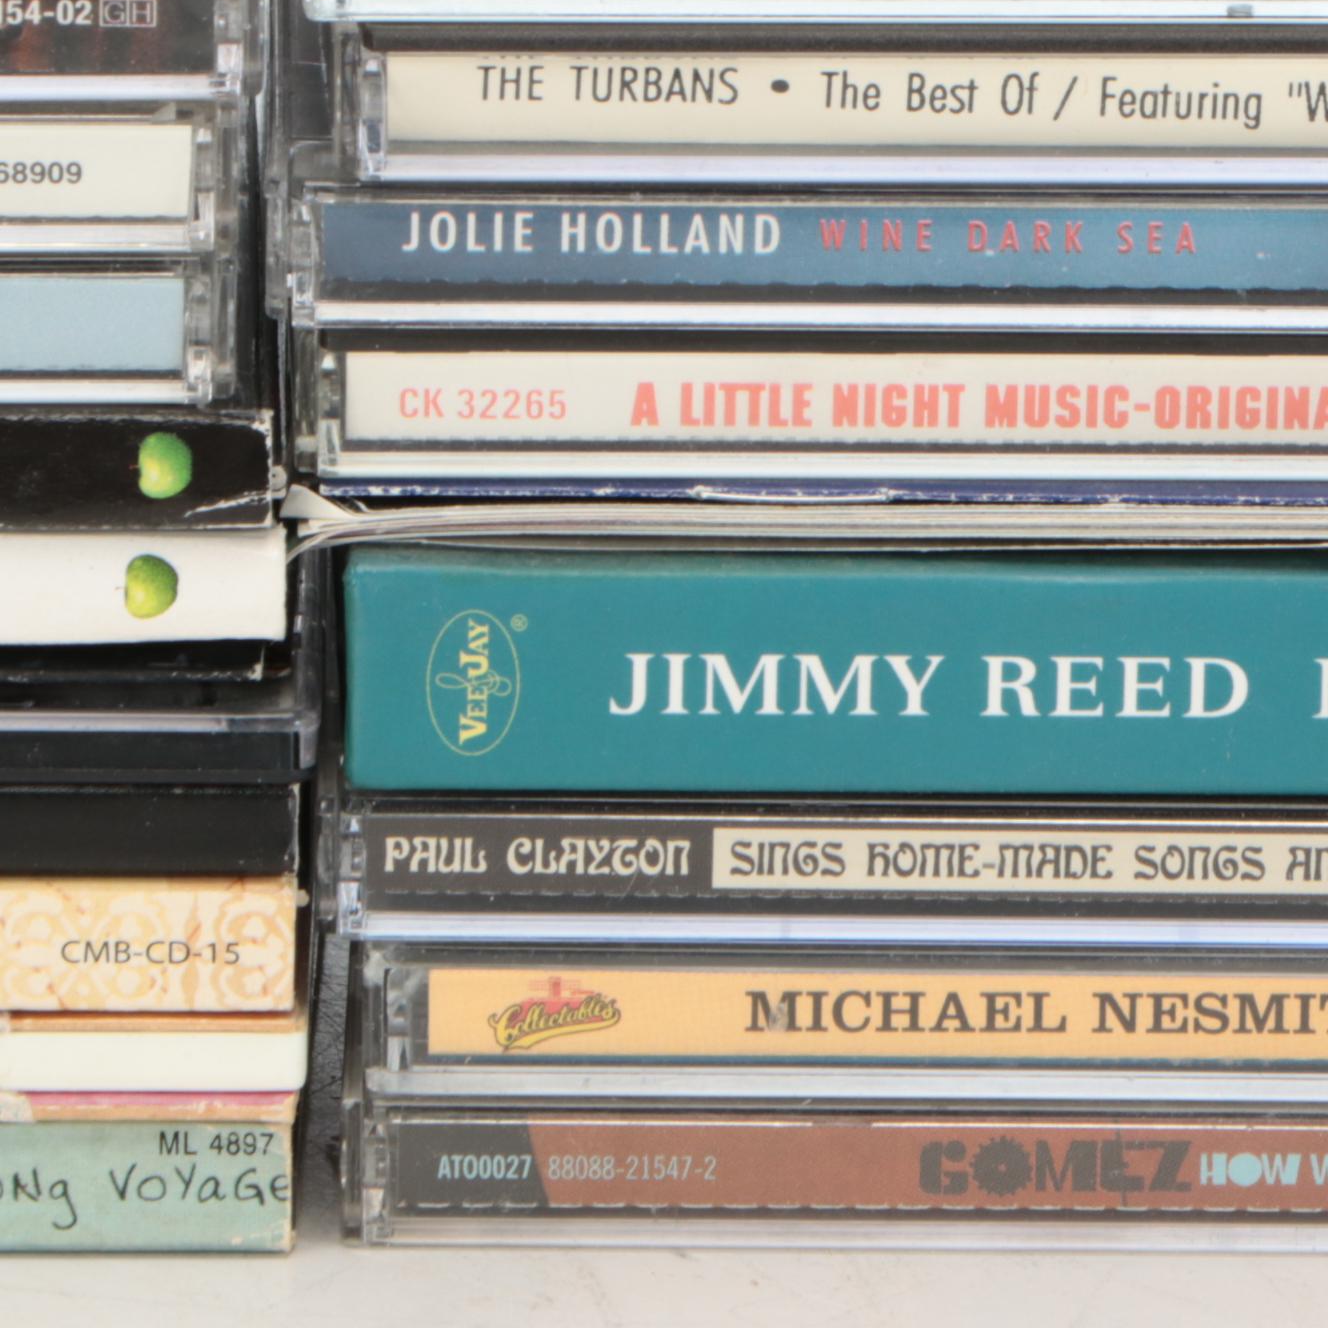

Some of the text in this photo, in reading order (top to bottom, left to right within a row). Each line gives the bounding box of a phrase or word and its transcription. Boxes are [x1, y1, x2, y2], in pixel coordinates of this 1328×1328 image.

[478, 65, 544, 100] THE
[570, 66, 738, 104] TURBANS
[821, 70, 880, 111] The
[907, 72, 978, 114] Best
[1001, 72, 1039, 116] Of
[1100, 76, 1262, 130] Featuring
[402, 211, 533, 252] JOLIE
[561, 211, 780, 255] HOLLAND
[820, 219, 931, 251] WINE
[968, 220, 1082, 254] DARK
[1117, 221, 1196, 254] SEA
[400, 388, 444, 419] CK
[458, 388, 567, 420] 32265
[631, 382, 659, 426] A
[681, 383, 813, 428] LITTLE
[832, 384, 966, 428] NIGHT
[610, 653, 944, 715] JIMMY
[982, 656, 1248, 717] REED
[385, 836, 487, 873] PAUL
[507, 837, 690, 876] CLAYTON
[730, 840, 845, 877] SINGS
[867, 842, 1113, 879] HOME-MADE
[1134, 844, 1265, 881] SONGS
[60, 940, 240, 964] CMB-CD-15
[487, 993, 622, 1048] Collectables
[746, 990, 1066, 1033] MICHAEL
[159, 1130, 274, 1156] ML 4897
[918, 1134, 1192, 1197] GOMEZ
[1200, 1153, 1301, 1187] HOW
[547, 1155, 716, 1182] 88088-21547-2
[0, 1168, 78, 1230] Ng
